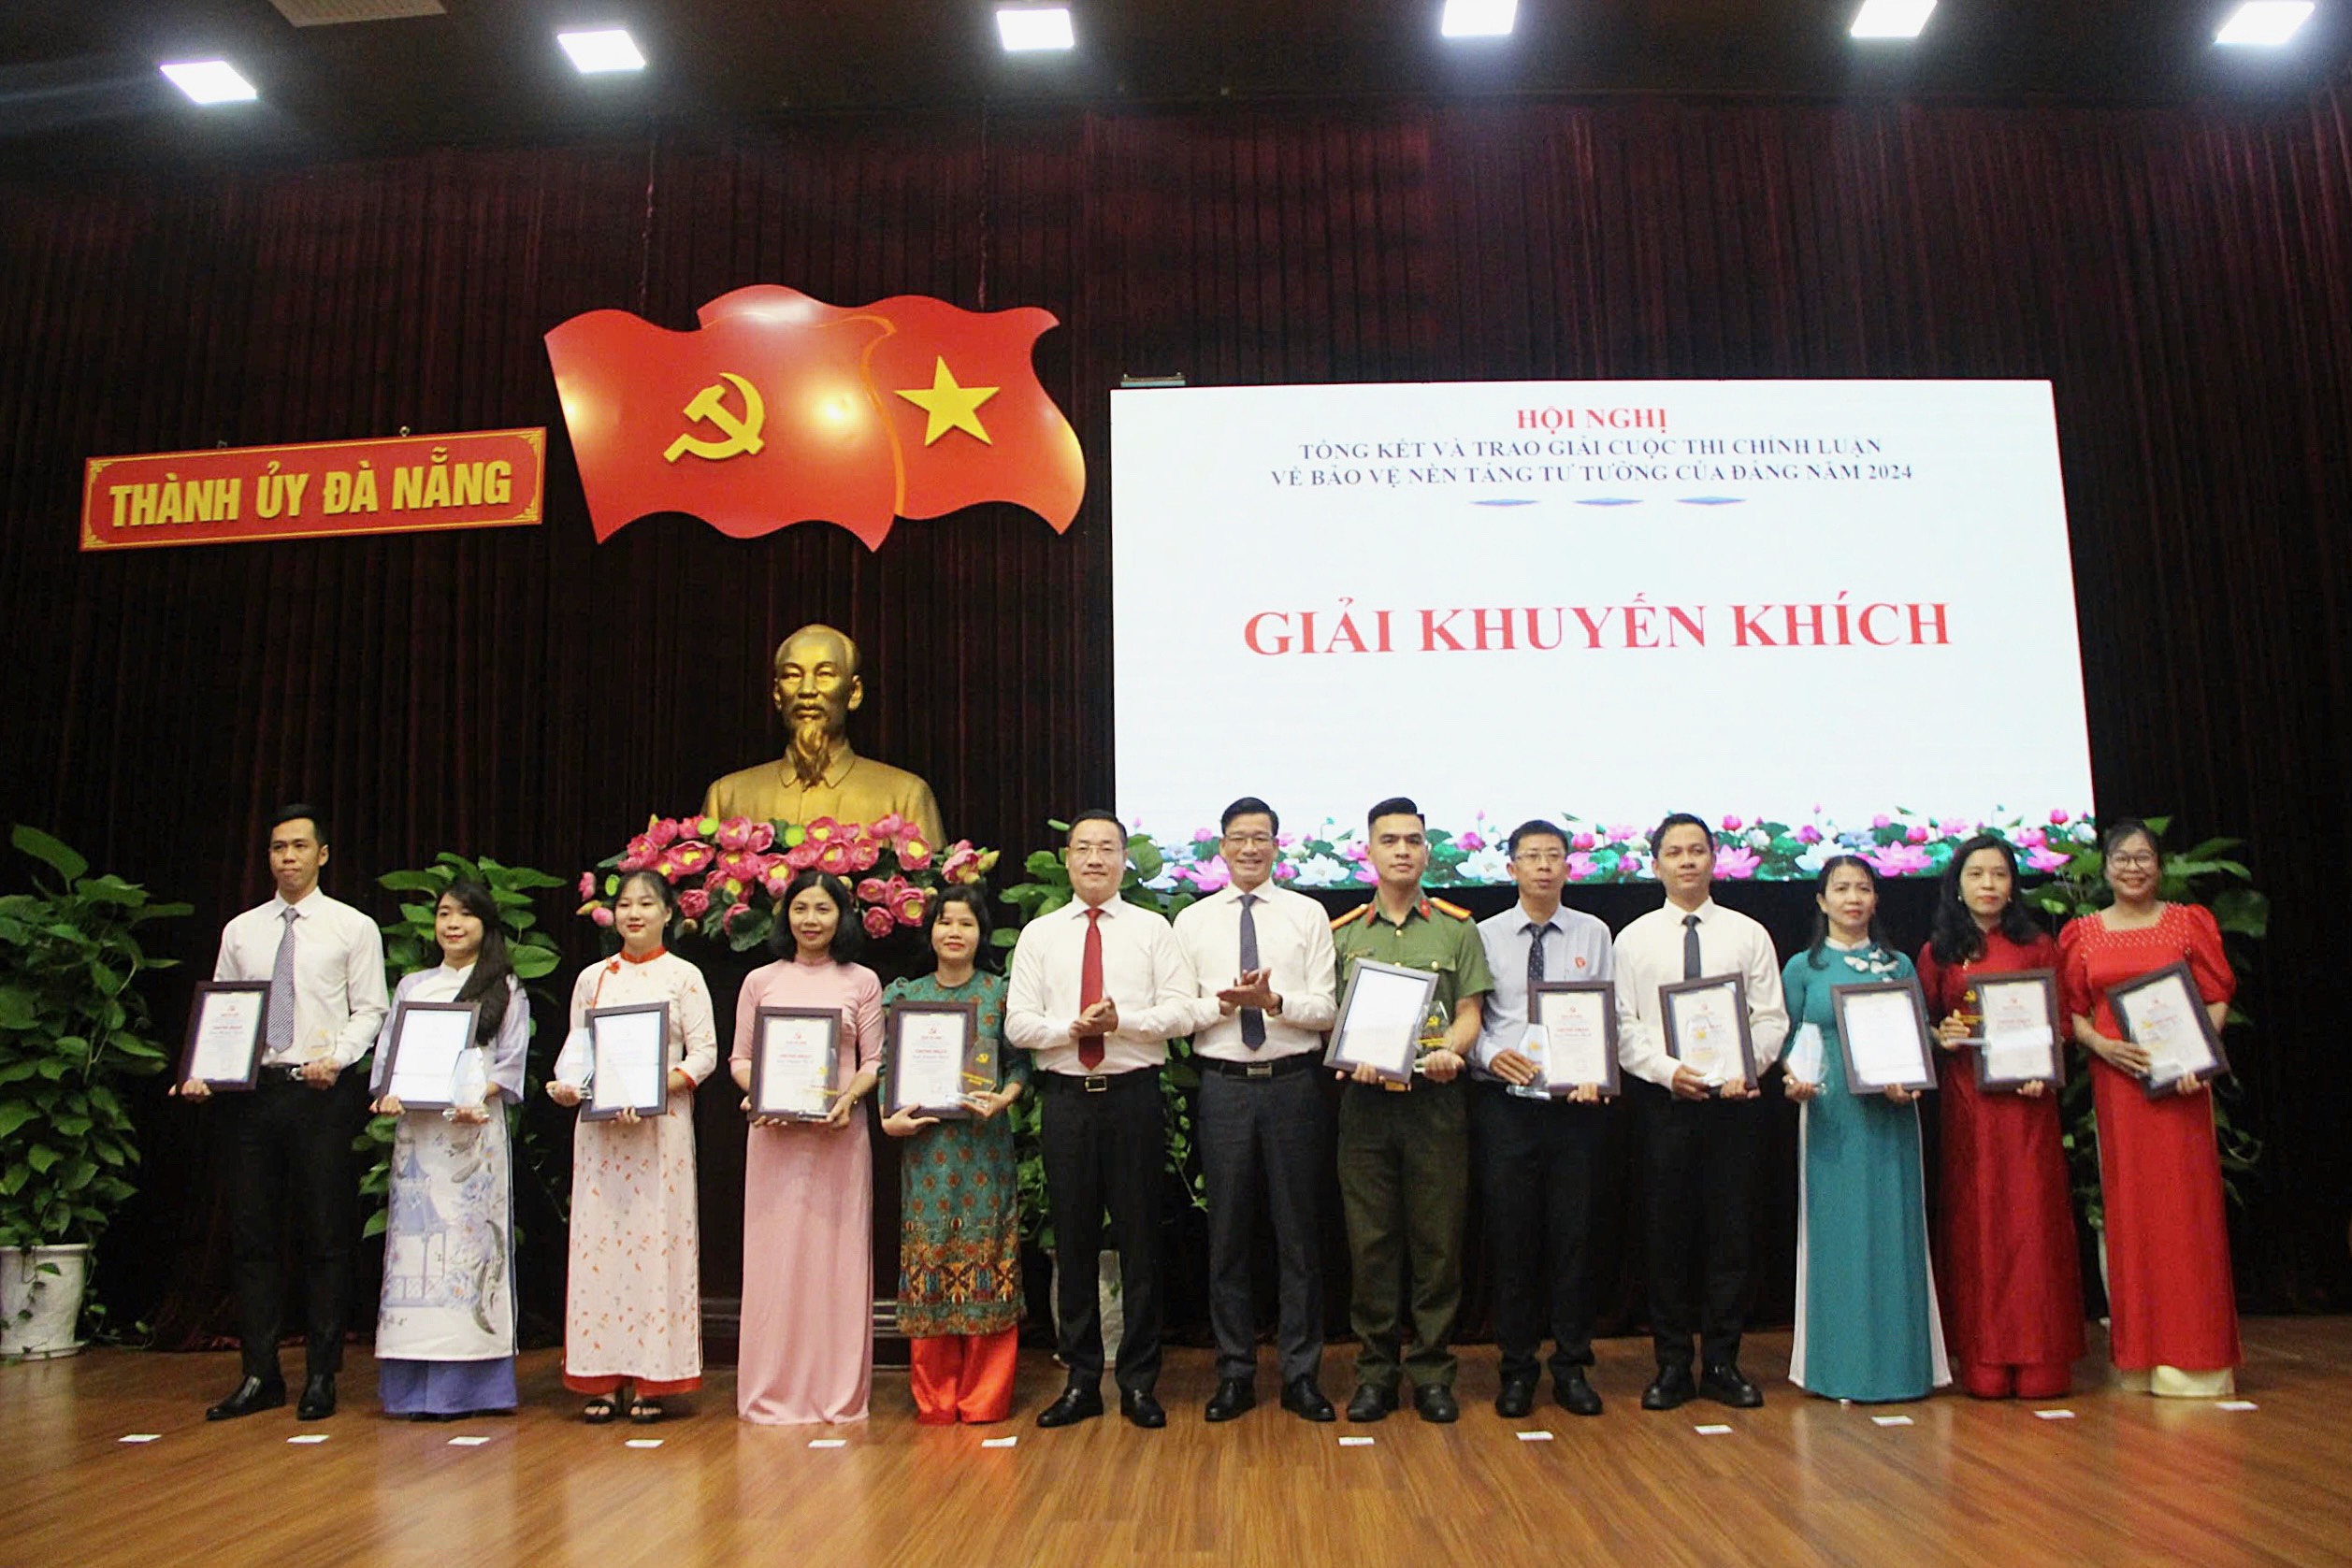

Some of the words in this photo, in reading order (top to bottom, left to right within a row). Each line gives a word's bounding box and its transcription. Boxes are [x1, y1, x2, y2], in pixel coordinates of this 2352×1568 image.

[1517, 406, 1576, 435] HỘI
[1586, 408, 1667, 434] NGHỊ
[1298, 438, 1369, 460] TỔNG
[1378, 437, 1427, 459] KẾT
[1432, 436, 1466, 458] VÀ
[1472, 440, 1541, 458] TRAO
[1549, 434, 1602, 456] GIẢI
[1609, 439, 1677, 460] CUỘC
[1683, 439, 1725, 455] THI
[1733, 433, 1811, 455] CHÍNH
[1817, 434, 1882, 458] LUẬN
[109, 473, 242, 527] THÀNH
[256, 461, 310, 519] ỦY
[323, 460, 379, 514] ĐÀ
[391, 447, 512, 510] NẴNG
[1270, 466, 1304, 487] VỀ
[1310, 464, 1362, 486] BẢO
[1368, 466, 1402, 488] VỆ
[1408, 462, 1457, 484] NỀN
[1465, 461, 1534, 484] TẢNG
[1538, 463, 1577, 482] TƯ
[1580, 460, 1668, 482] TƯỞNG
[1676, 458, 1726, 482] CỦA
[1731, 459, 1799, 481] ĐẢNG
[1806, 459, 1862, 481] NĂM
[1868, 463, 1913, 481] 2024
[1243, 597, 1393, 656] GIẢI
[1418, 592, 1706, 653] KHUYẾN
[1731, 590, 1951, 648] KHÍCH
